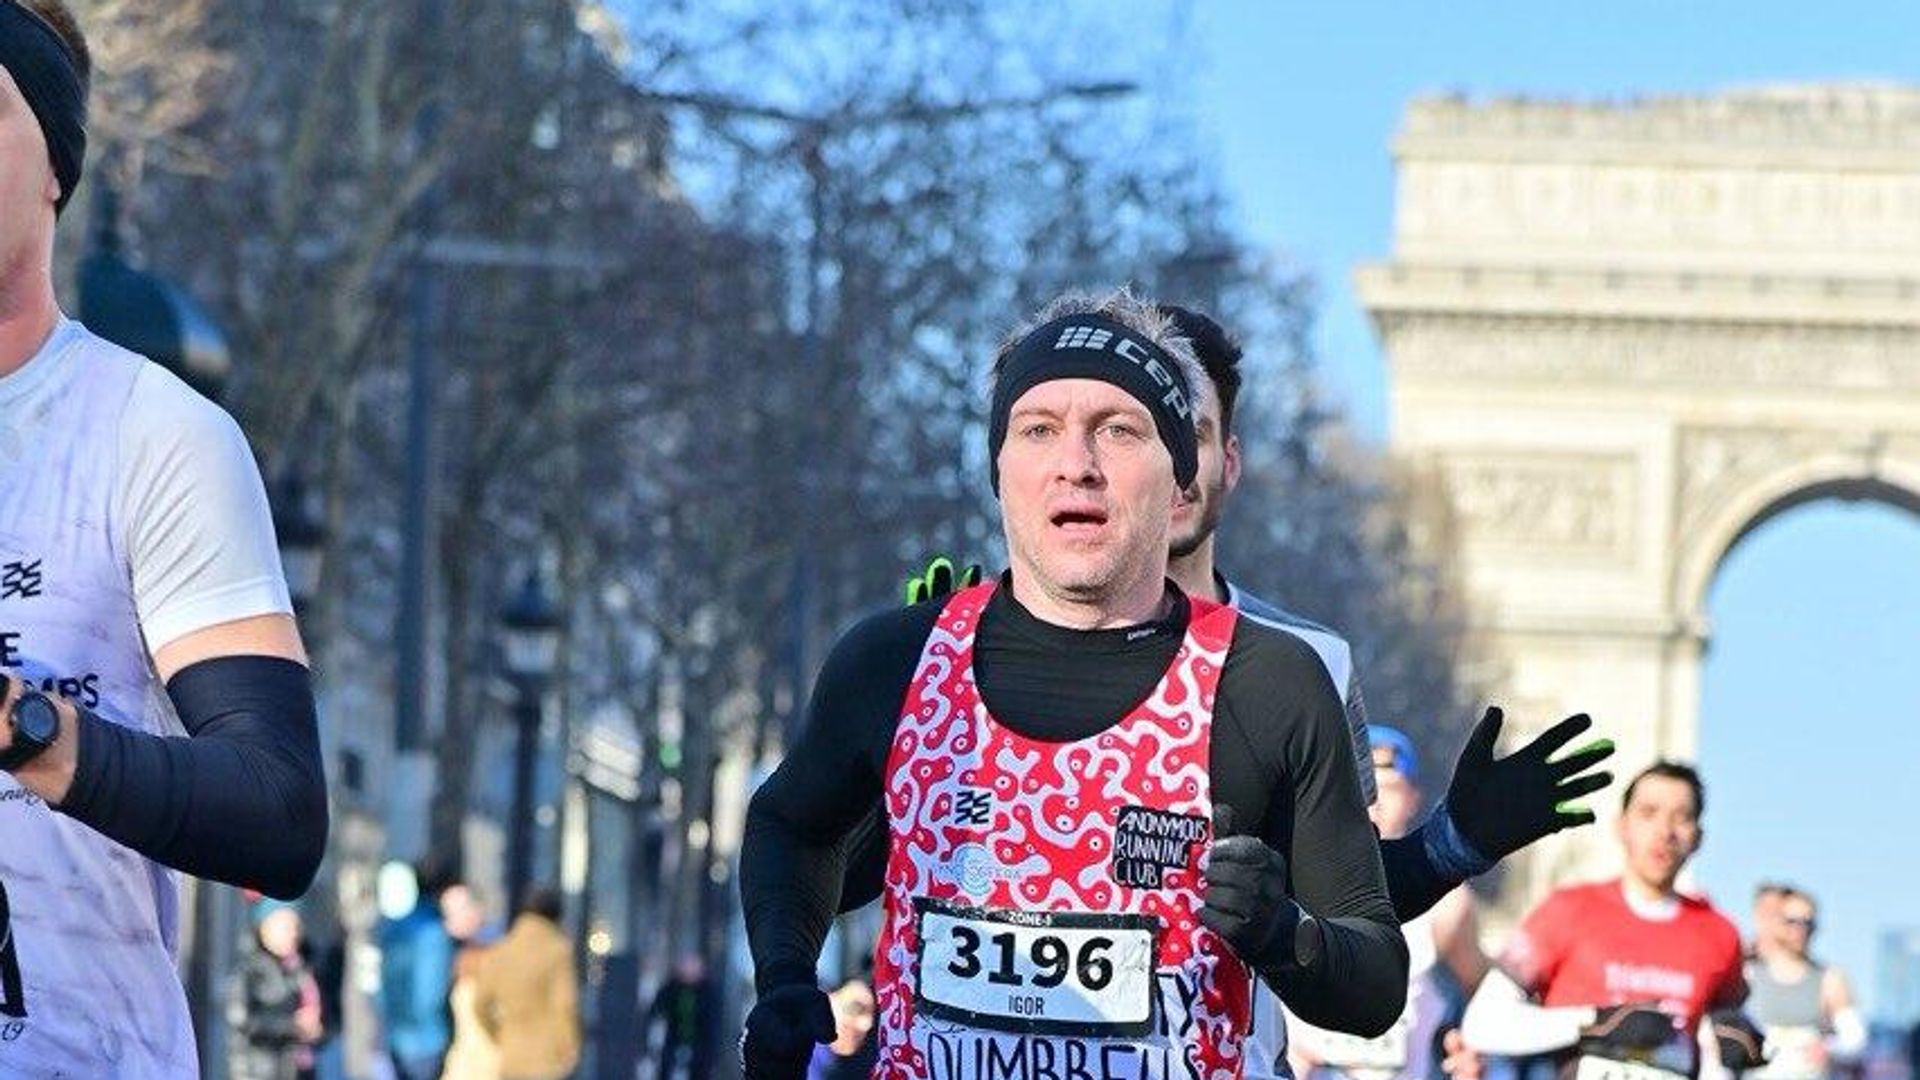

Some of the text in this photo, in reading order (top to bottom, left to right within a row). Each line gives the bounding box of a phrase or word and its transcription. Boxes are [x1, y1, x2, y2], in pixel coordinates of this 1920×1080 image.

[1119, 811, 1207, 843] ANONYMOUS
[1114, 831, 1189, 867] RUNNING
[1114, 857, 1159, 887] CLUB
[947, 926, 1115, 992] 3196
[1008, 994, 1046, 1016] IGOR
